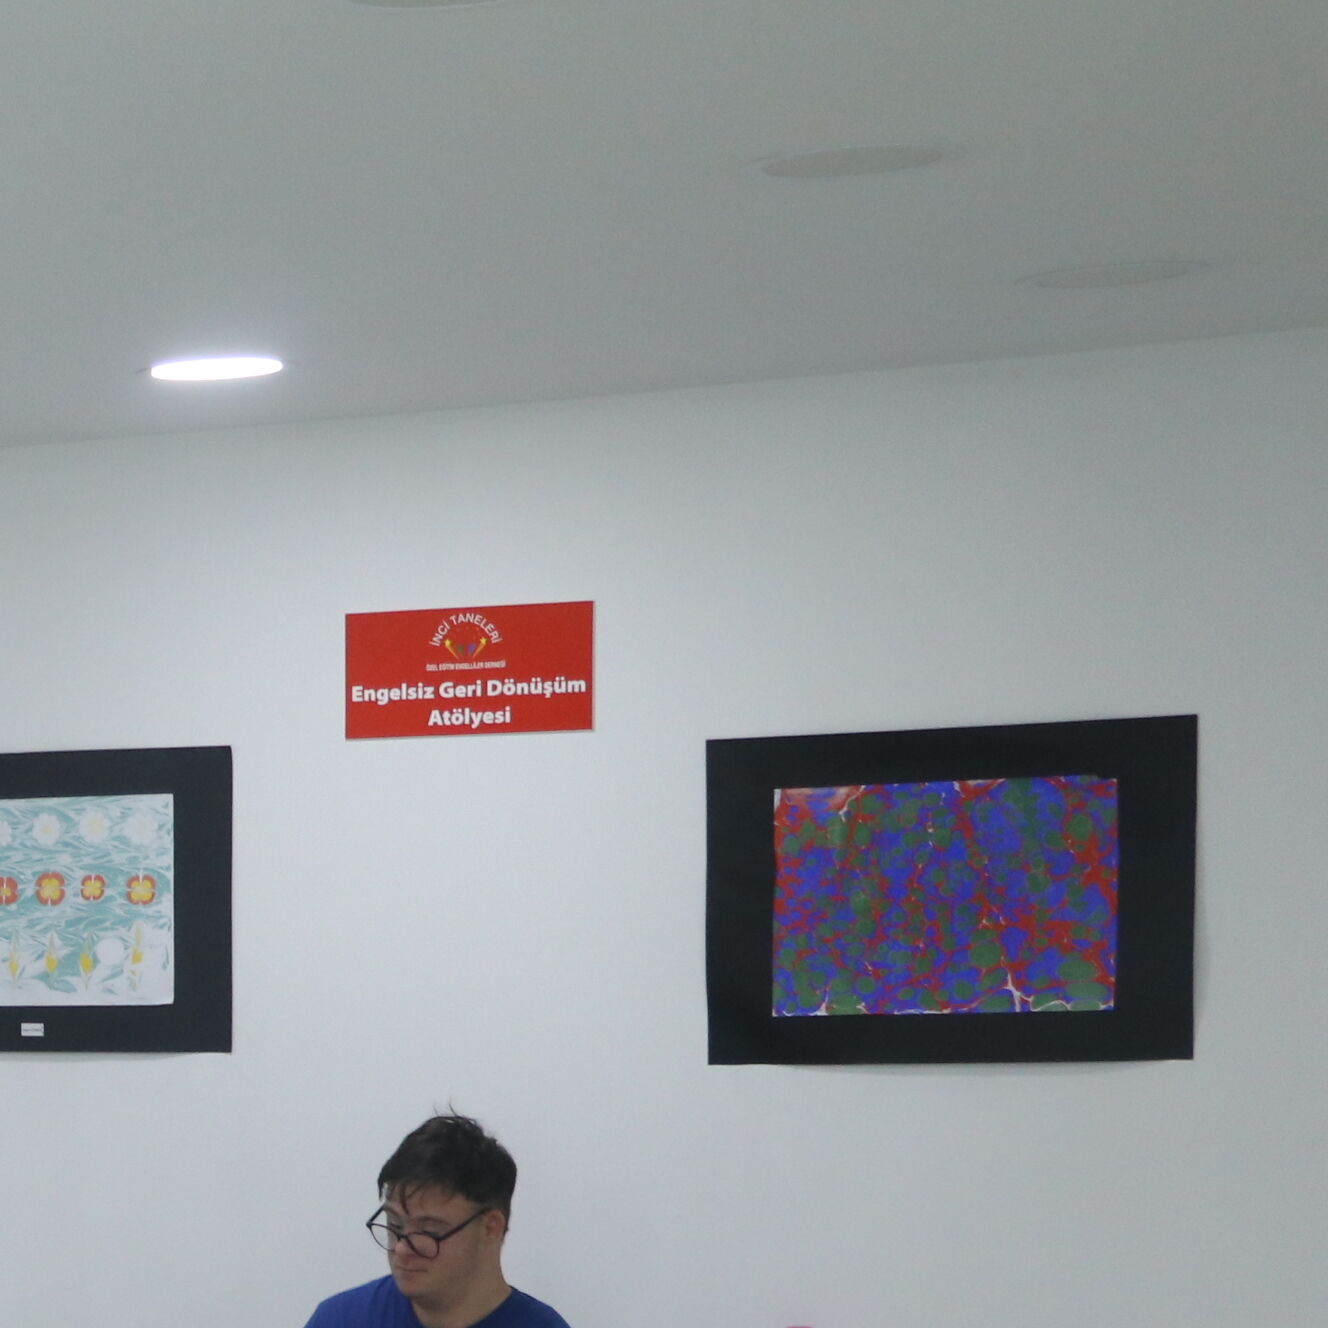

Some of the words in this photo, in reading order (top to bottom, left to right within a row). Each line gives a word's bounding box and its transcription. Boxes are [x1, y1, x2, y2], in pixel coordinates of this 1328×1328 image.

[428, 620, 451, 647] İNCİ
[449, 613, 503, 644] TANELERİ
[351, 682, 435, 705] Engelsiz
[439, 679, 482, 698] Geri
[487, 676, 587, 698] Dönüşüm
[427, 706, 511, 728] Atölyesi
